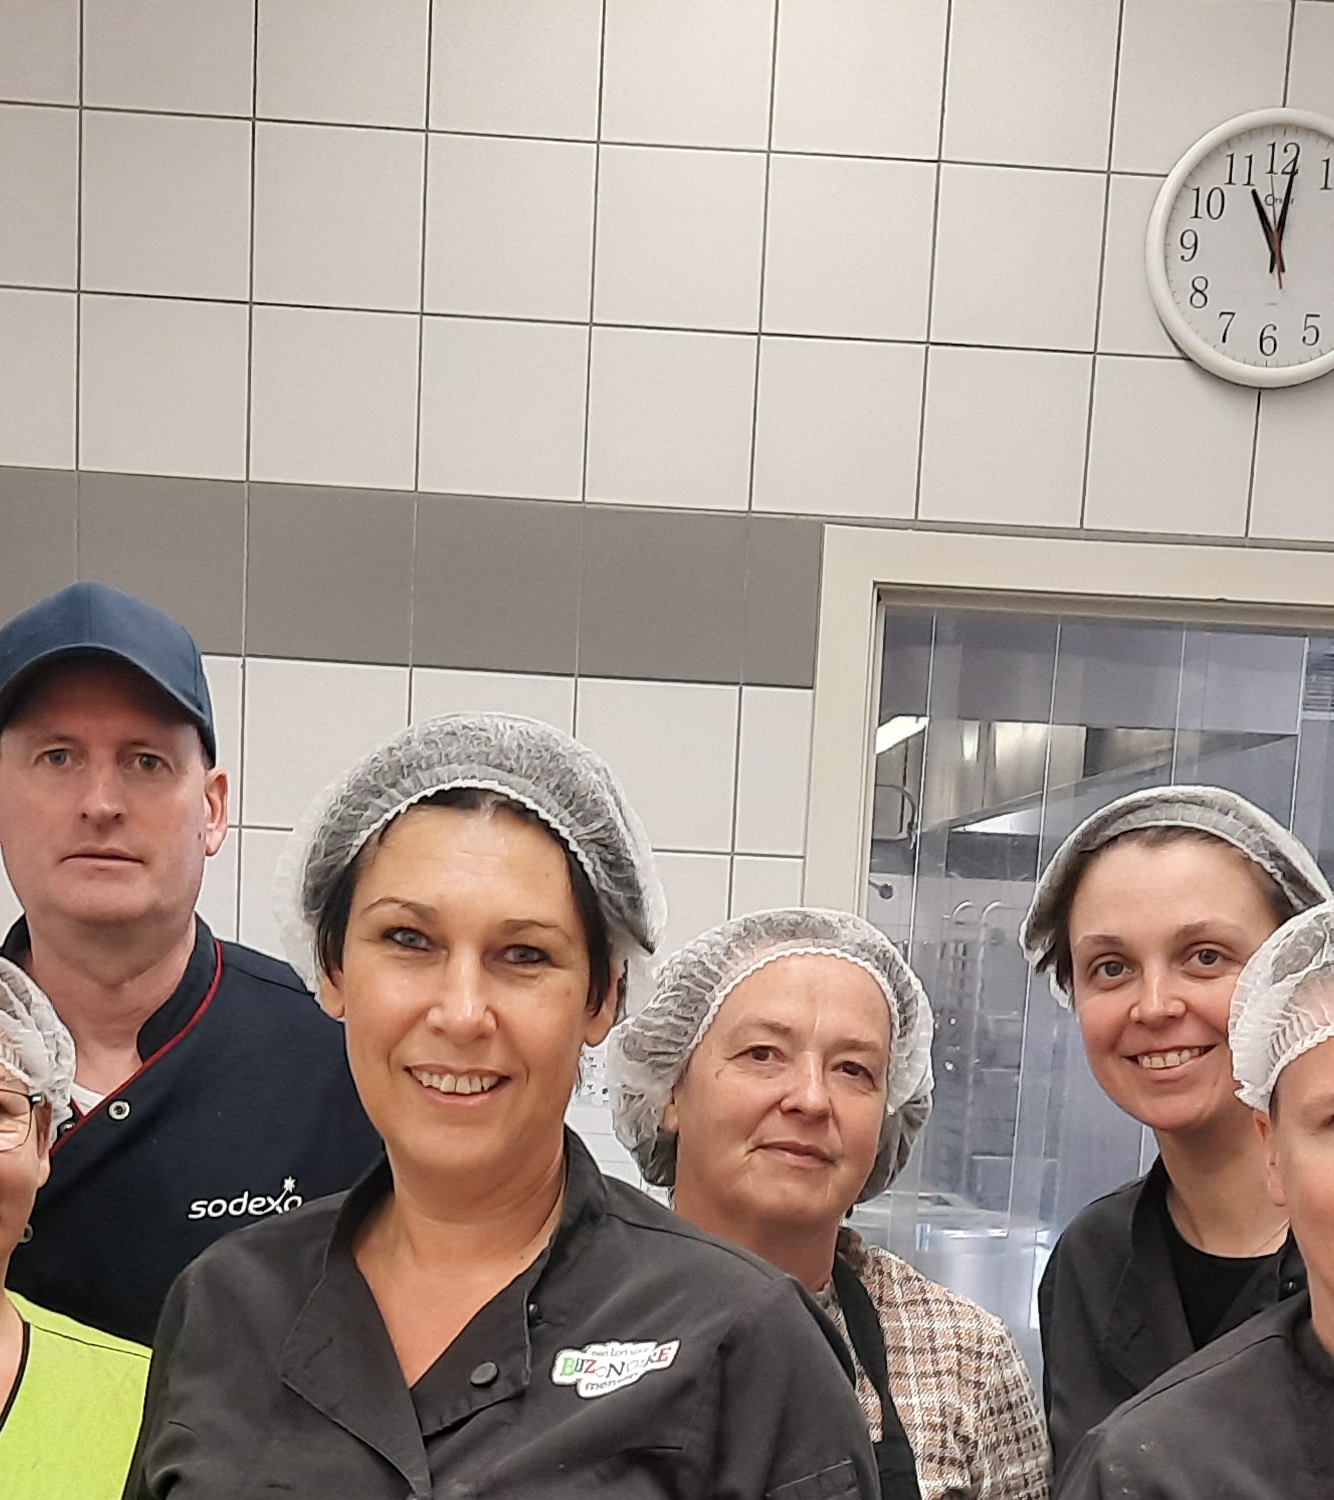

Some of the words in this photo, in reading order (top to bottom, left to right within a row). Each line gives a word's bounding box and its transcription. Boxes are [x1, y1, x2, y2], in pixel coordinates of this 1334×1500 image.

[1224, 152, 1255, 186] 11
[1265, 141, 1301, 176] 12
[1319, 157, 1333, 190] 1
[1190, 187, 1225, 220] 10
[1180, 229, 1199, 262] 9
[1189, 276, 1209, 309] 8
[1218, 311, 1236, 343] 7
[1259, 324, 1277, 356] 6
[1302, 314, 1321, 346] 5
